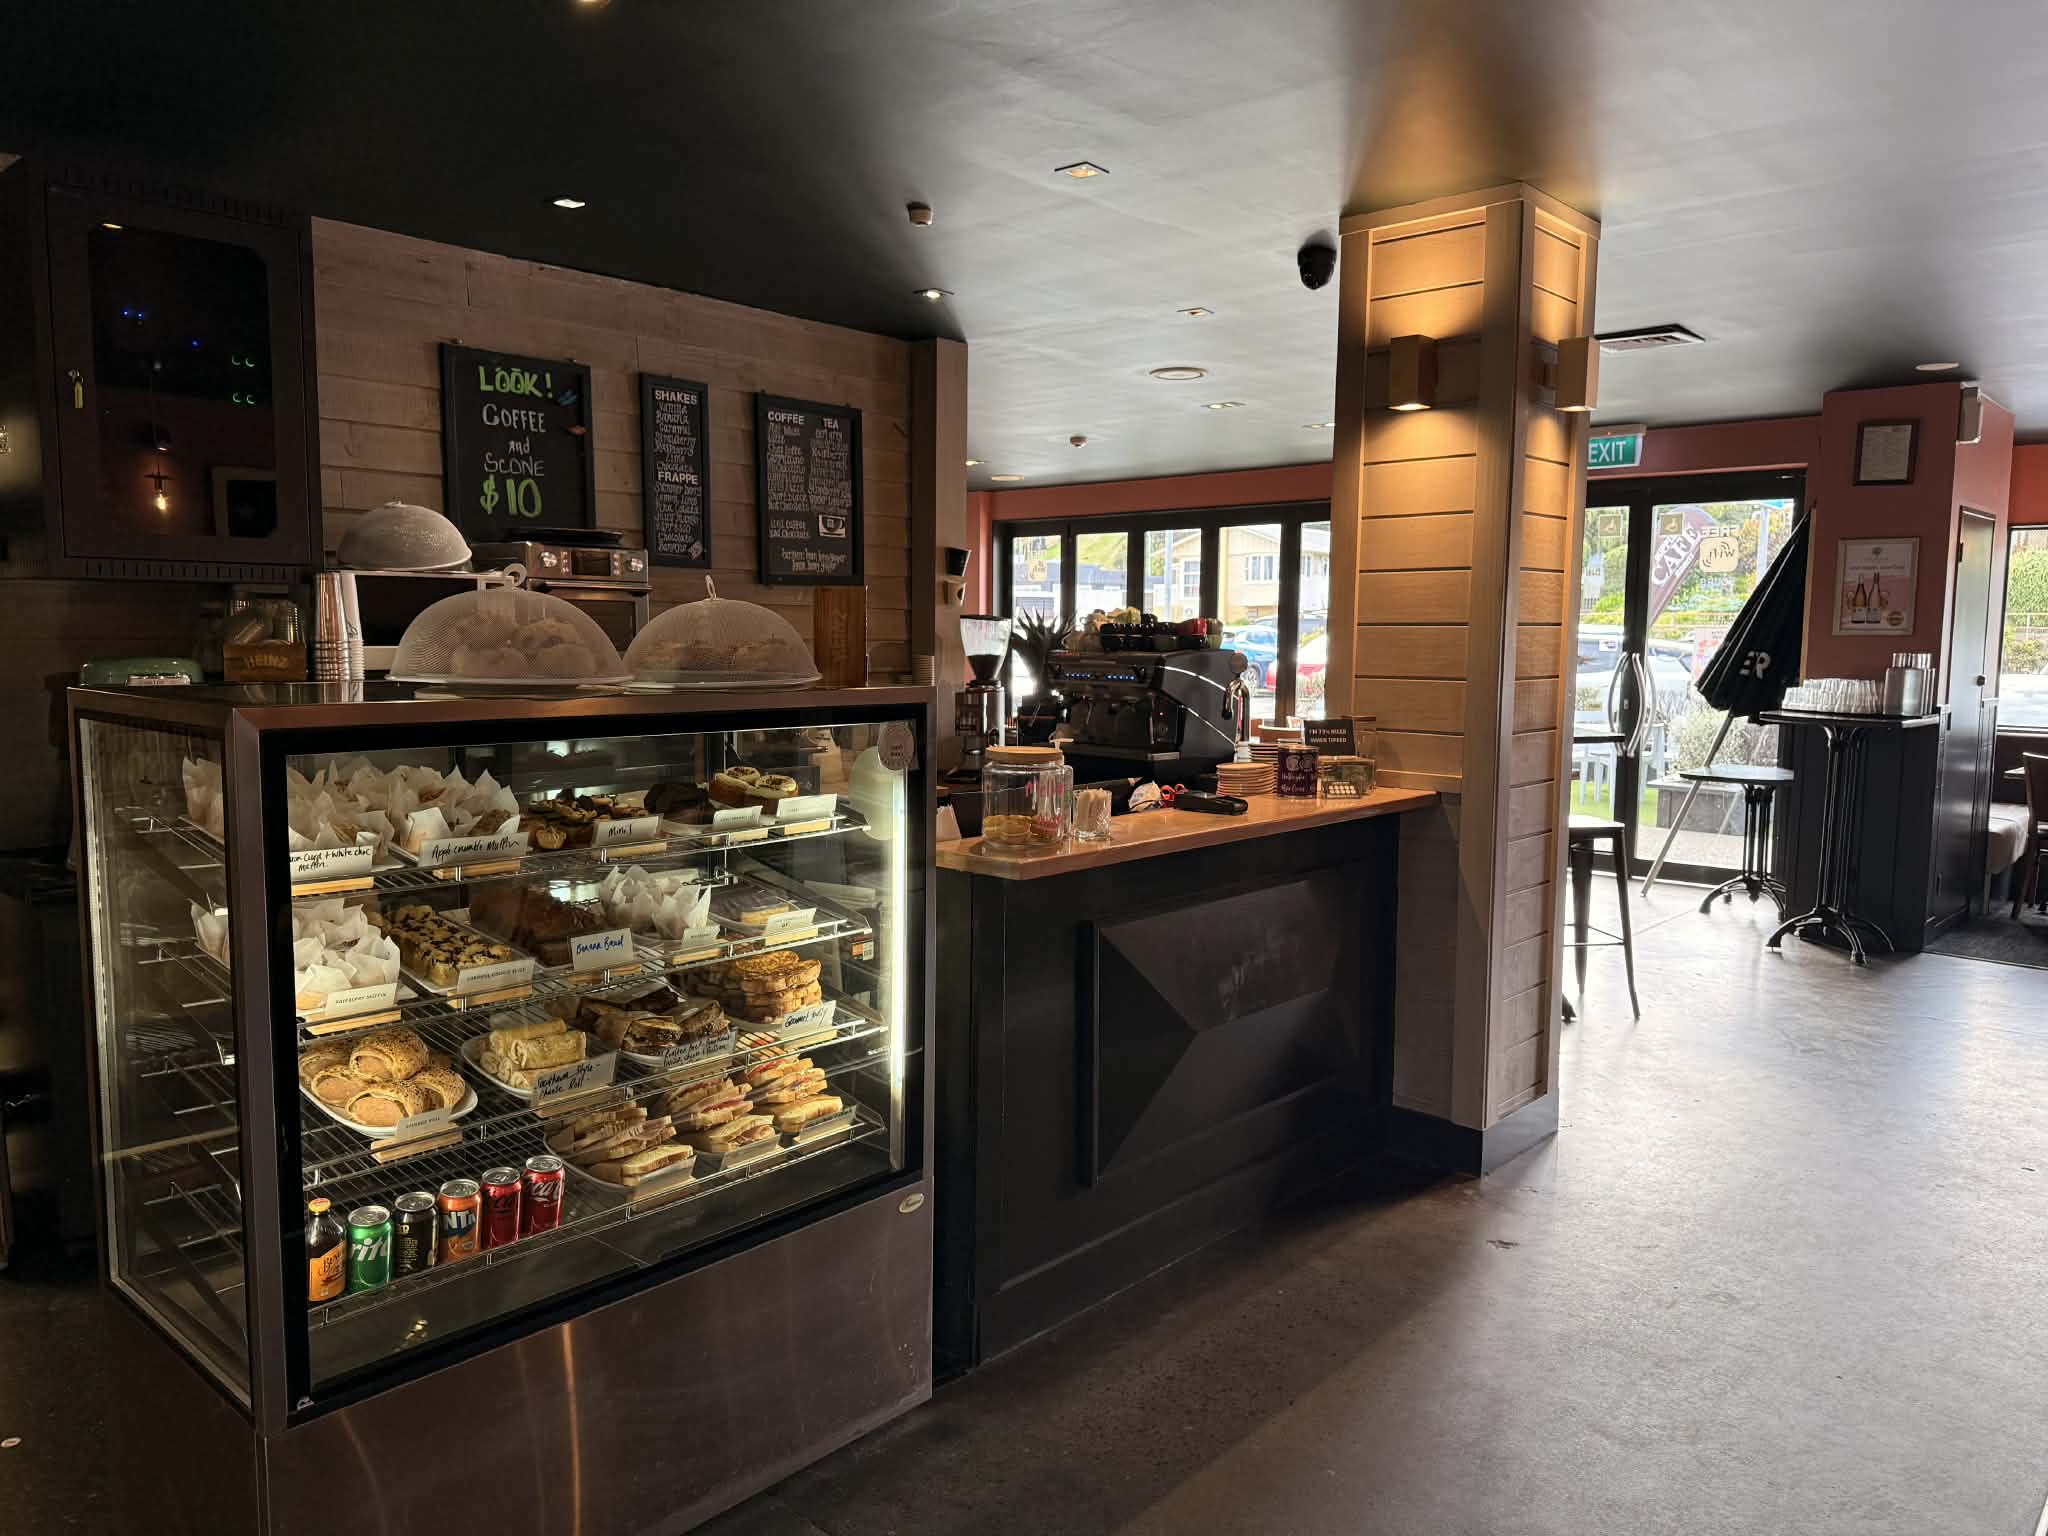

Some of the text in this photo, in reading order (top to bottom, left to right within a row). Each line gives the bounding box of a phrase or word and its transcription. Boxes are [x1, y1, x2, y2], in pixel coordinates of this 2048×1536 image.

[656, 390, 698, 405] SHAKES
[767, 411, 805, 425] COFFEE
[823, 418, 840, 430] TEA
[508, 436, 531, 455] and
[1588, 441, 1627, 463] EXIT
[658, 471, 699, 485] FRAPPE
